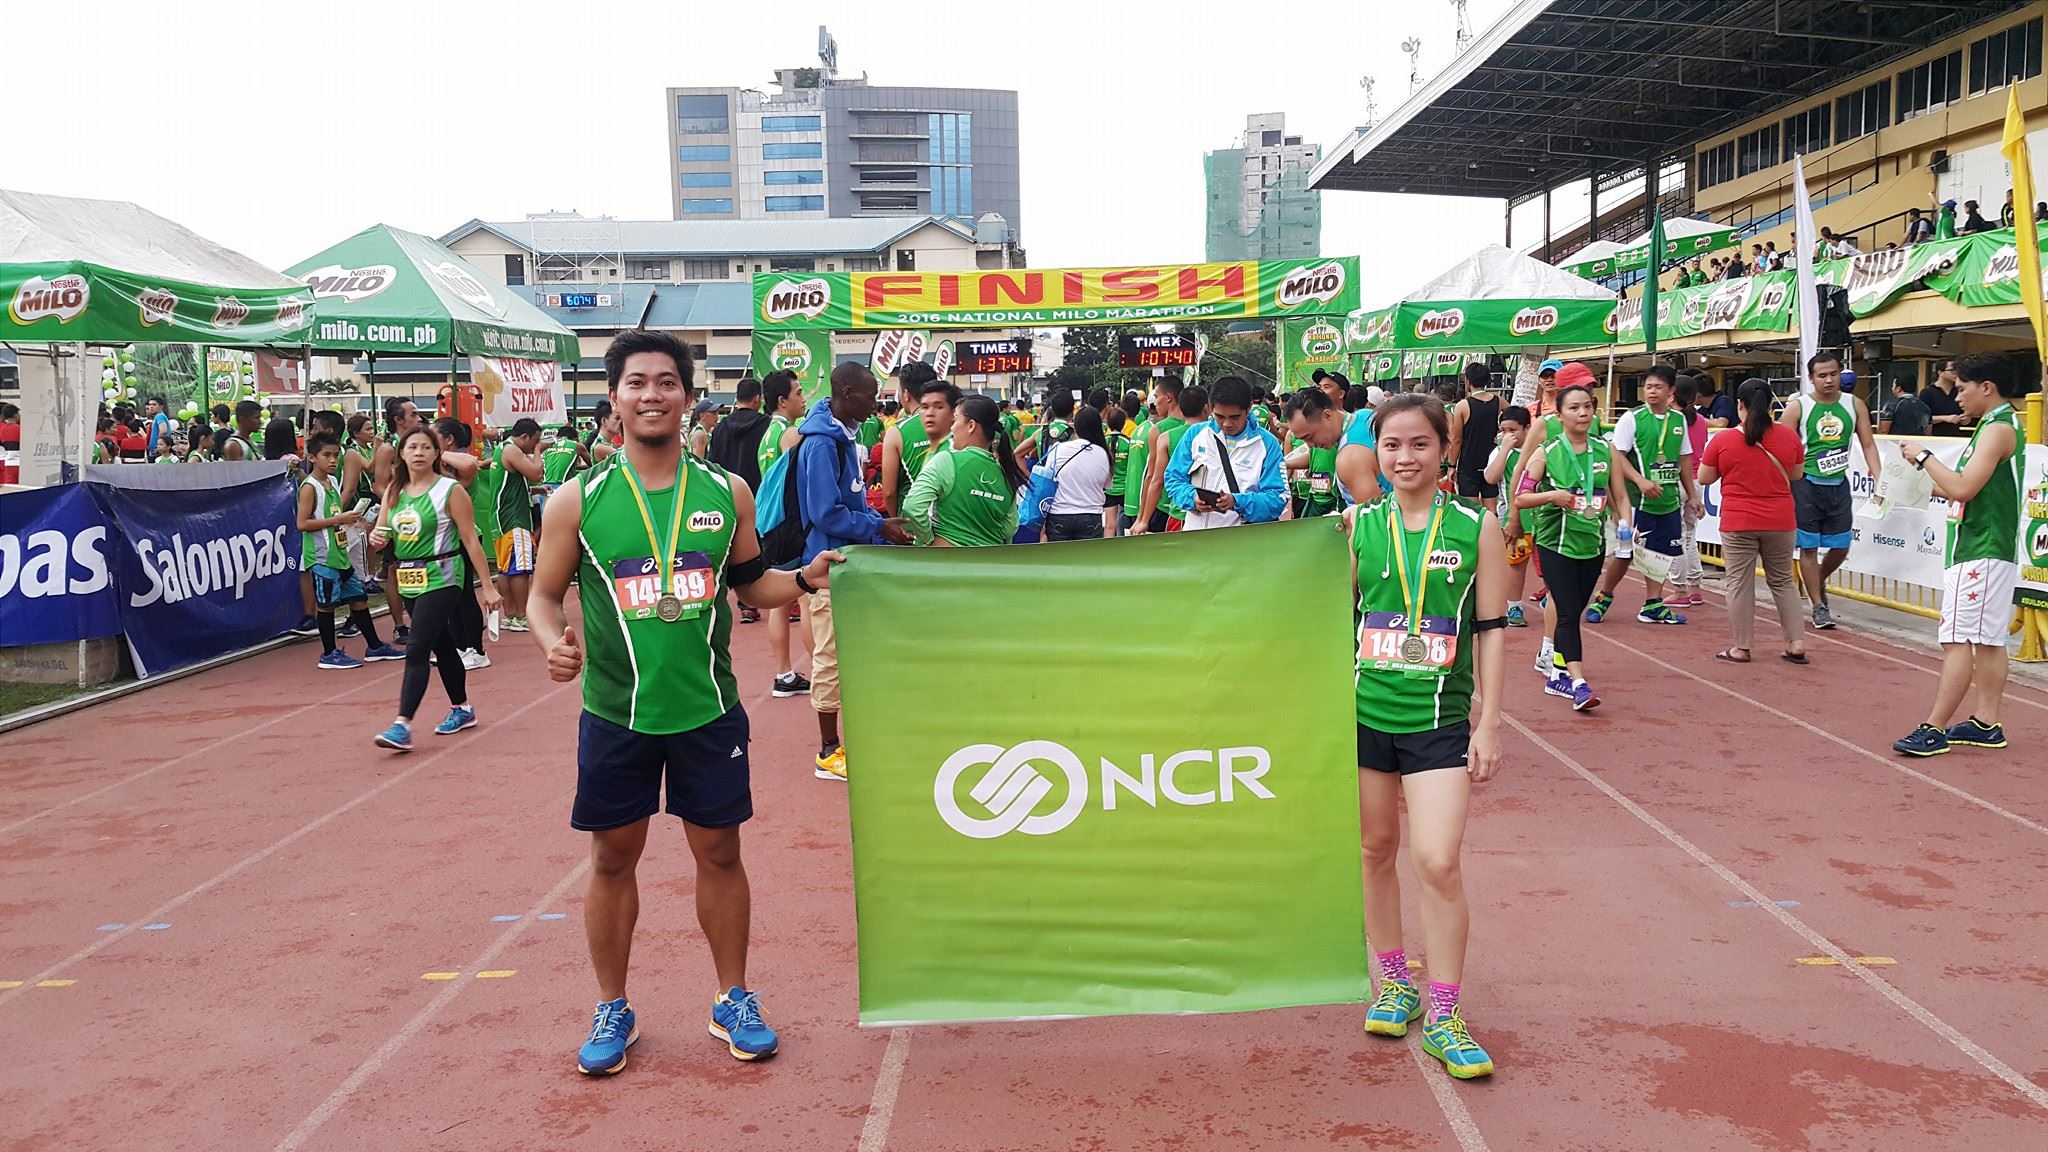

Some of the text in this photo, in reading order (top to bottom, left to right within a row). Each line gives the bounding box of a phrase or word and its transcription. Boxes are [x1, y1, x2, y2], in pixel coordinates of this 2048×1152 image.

[1989, 255, 2018, 276] MIL
[50, 279, 80, 289] Nestlé
[306, 276, 385, 293] MILO
[863, 265, 1245, 308] FINISH
[1284, 274, 1337, 299] MILO
[19, 288, 82, 313] MILO
[771, 290, 824, 312] MILO
[898, 304, 1215, 323] 2016 NATIONAL MILO MARATHON
[1421, 316, 1460, 332] MILO
[1516, 314, 1555, 330] MILO
[970, 342, 1018, 355] TIMEX
[1132, 336, 1181, 348] TIMEX
[977, 356, 1030, 372] 1:37:41
[1140, 350, 1193, 366] 1:07:40
[692, 516, 721, 527] MILO
[1873, 532, 1906, 548] Hisense
[130, 525, 287, 608] Salonpas
[1429, 555, 1459, 566] MILO
[1100, 745, 1277, 811] NCR
